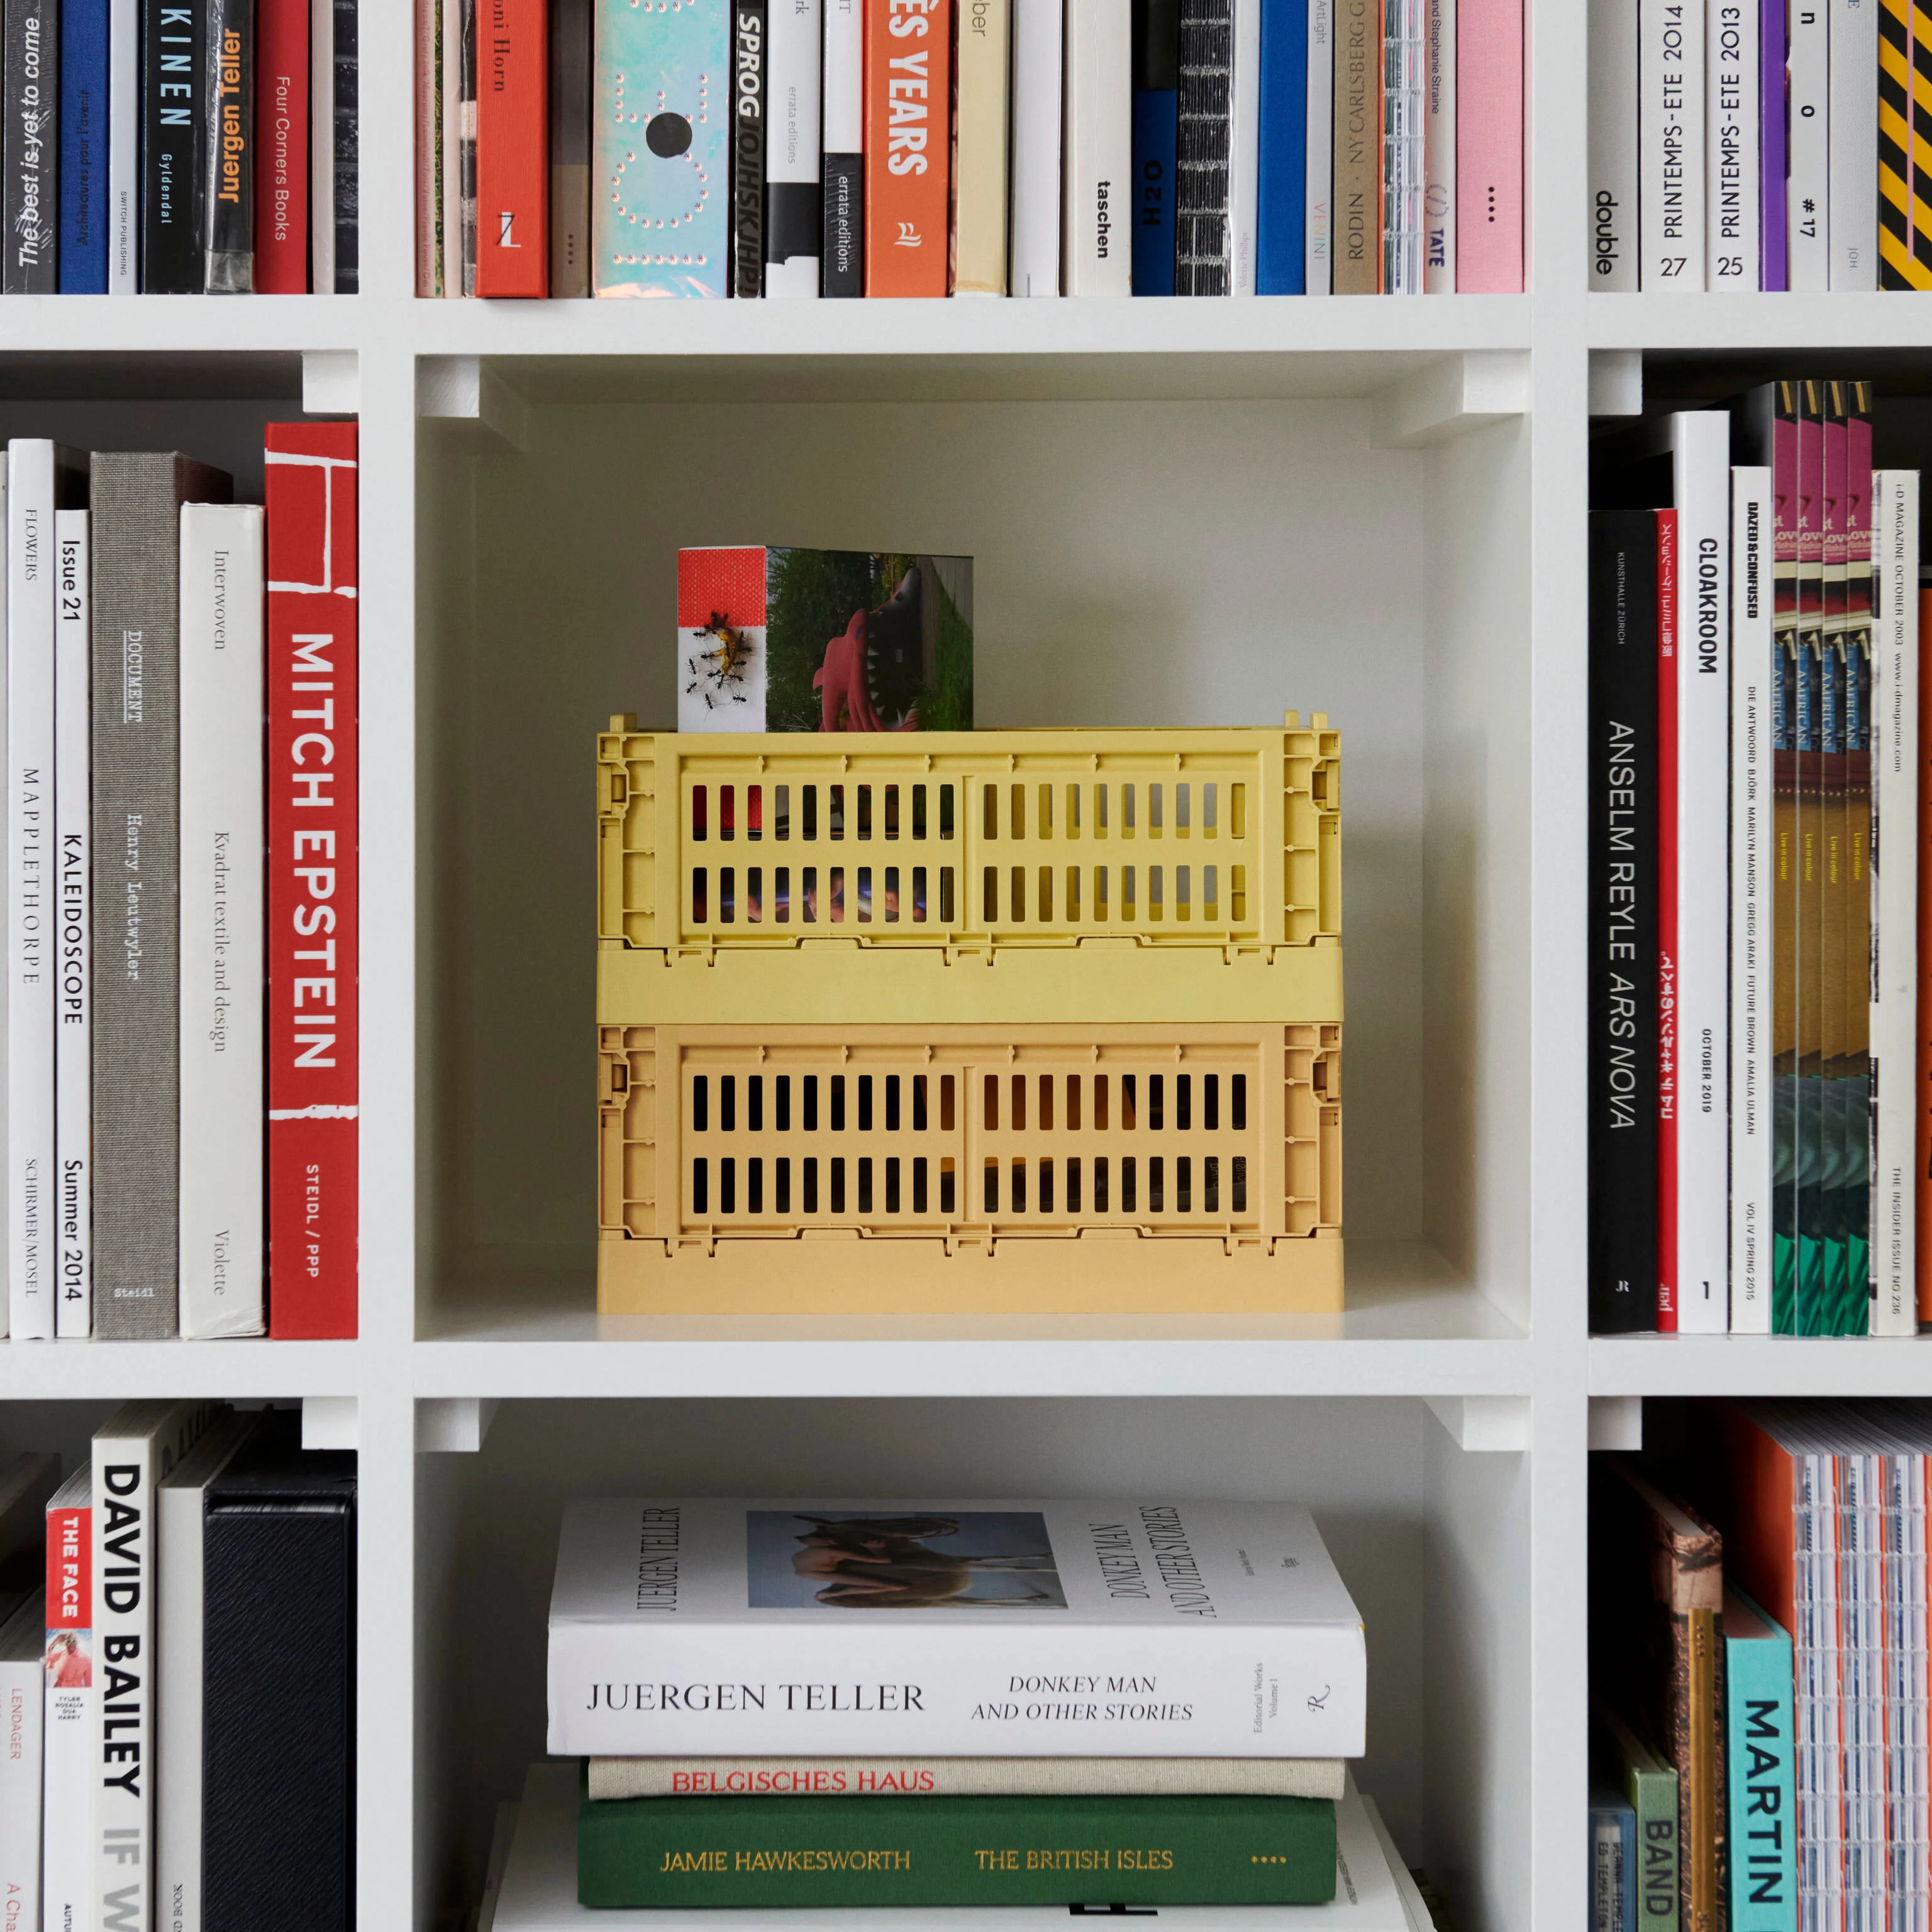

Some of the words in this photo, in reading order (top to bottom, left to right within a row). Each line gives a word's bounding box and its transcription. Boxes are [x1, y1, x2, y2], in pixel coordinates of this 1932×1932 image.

[1431, 0, 1441, 17] and
[23, 17, 40, 79] come
[1430, 19, 1441, 75] Stephanie
[1663, 6, 1683, 60] 2014
[1721, 8, 1740, 61] 2013
[160, 9, 191, 125] KINEN
[220, 28, 240, 97] Teller
[494, 39, 510, 91] Horn
[738, 13, 760, 118] SPROG
[1349, 21, 1365, 133] CARLSBERG
[20, 86, 40, 106] to
[277, 77, 290, 114] Four
[789, 87, 797, 118] errata
[888, 50, 928, 175] YEARS
[1431, 75, 1442, 114] Straine
[21, 113, 43, 149] yet
[77, 139, 92, 165] pour
[276, 118, 290, 184] Corners
[787, 121, 798, 164] editions
[1349, 134, 1363, 163] NY
[20, 155, 39, 169] is
[219, 106, 244, 203] Juergen
[19, 174, 38, 221] best
[159, 154, 172, 223] Gyldendal
[838, 176, 849, 216] errata
[275, 190, 289, 240] Books
[1097, 181, 1111, 258] taschen
[1313, 201, 1326, 258] VENINI
[1348, 194, 1363, 259] RODIN
[1596, 191, 1618, 275] double
[19, 230, 38, 267] The
[838, 219, 851, 272] editions
[1430, 229, 1446, 267] TATE
[1661, 258, 1687, 276] 27
[1718, 257, 1743, 275] 25
[1747, 502, 1758, 541] DAZED
[1894, 502, 1904, 561] MAGAZINE
[26, 510, 37, 580] FLOWERS
[63, 541, 80, 591] Issue
[64, 597, 80, 619] 21
[215, 551, 229, 650] Interwoven
[1699, 538, 1718, 673] CLOAKROOM
[1747, 553, 1758, 618] CONFUSED
[1894, 565, 1904, 616] OCTOBER
[1894, 620, 1904, 645] 2003
[128, 631, 142, 722] DOCUMENT
[1748, 686, 1756, 702] DIE
[292, 634, 334, 806] MITCH
[1772, 669, 1782, 742] AMERICAN
[1797, 670, 1806, 743] AMERICAN
[1823, 672, 1831, 745] AMERICAN
[1846, 669, 1855, 742] AMERICAN
[1892, 653, 1904, 772] www.i-dmagazine.com
[1748, 706, 1756, 763] ANTWOORD
[1609, 721, 1635, 850] ANSELM
[1748, 769, 1758, 801] BJÖRK
[125, 814, 142, 870] Henry
[1747, 807, 1755, 850] MARILYN
[1780, 833, 1789, 848] Live
[1830, 836, 1839, 851] Live
[24, 769, 39, 982] MAPPLETHORPE
[215, 833, 230, 894] Kvadrat
[1747, 853, 1755, 897] MANSON
[1780, 857, 1789, 880] colour
[1830, 860, 1839, 884] colour
[64, 835, 82, 1023] KALEIDOSCOPE
[125, 882, 142, 980] Leutwyler
[215, 899, 230, 954] textile
[1610, 863, 1635, 960] REYLE
[1747, 902, 1755, 936] GREGG
[294, 831, 336, 1067] EPSTEIN
[1747, 939, 1755, 969] ARAKI
[214, 960, 230, 994] and
[1746, 975, 1755, 1013] FUTURE
[209, 996, 230, 1052] design
[1609, 972, 1635, 1038] ARS
[1702, 1029, 1711, 1079] OCTOBER
[1746, 1017, 1755, 1053] BROWN
[1610, 1045, 1635, 1128] NOVA
[1702, 1085, 1711, 1112] 2019
[1746, 1060, 1755, 1097] AMALIA
[1746, 1100, 1755, 1135] ULMAN
[306, 1165, 319, 1224] STEIDL
[1892, 1167, 1901, 1187] THE
[65, 1160, 82, 1241] Summer
[1746, 1202, 1755, 1221] VOL
[1892, 1192, 1901, 1235] INSIDER
[26, 1159, 38, 1298] SCHIRMER/MOSEL
[1746, 1224, 1755, 1234] IV
[65, 1250, 82, 1301] 2014
[214, 1230, 230, 1295] Violette
[307, 1245, 319, 1277] PPP
[1746, 1237, 1755, 1274] SPRING
[1892, 1240, 1901, 1272] ISSUE
[114, 1288, 155, 1297] Steidl
[1703, 1281, 1709, 1299] 1
[63, 1517, 78, 1557] THE
[104, 1465, 140, 1613] DAVID
[641, 1508, 679, 1554] TELLER
[1089, 1523, 1133, 1550] MAN
[1139, 1506, 1190, 1550] STORIES
[62, 1564, 78, 1618] FACE
[637, 1557, 677, 1611] JUERGEN
[1097, 1552, 1150, 1598] DONKEY
[1155, 1553, 1204, 1590] OTHER
[1170, 1592, 1216, 1618] AND
[587, 1685, 764, 1709] JUERGEN
[779, 1685, 926, 1710] TELLER
[1010, 1677, 1099, 1692] DONKEY
[1108, 1677, 1155, 1692] MAN
[1253, 1662, 1263, 1692] Works
[11, 1689, 22, 1759] LENDAGER
[104, 1635, 140, 1797] BAILEY
[972, 1704, 1018, 1719] AND
[1026, 1704, 1097, 1719] OTHER
[1105, 1704, 1192, 1719] STORIES
[1253, 1694, 1263, 1733] Editorial
[1269, 1684, 1278, 1718] Volume
[672, 1772, 847, 1792] BELGISCHES
[858, 1771, 935, 1792] HAUS
[1746, 1701, 1783, 1903] MARTIN
[103, 1828, 140, 1865] IF
[660, 1852, 727, 1872] JAMIE
[735, 1851, 909, 1871] HAWKESWORTH
[975, 1850, 1019, 1870] THE
[1027, 1850, 1109, 1870] BRITISH
[1118, 1850, 1172, 1870] ISLES
[1645, 1820, 1674, 1916] BAND
[7, 1883, 20, 1895] A
[174, 1884, 182, 1916] BOOK
